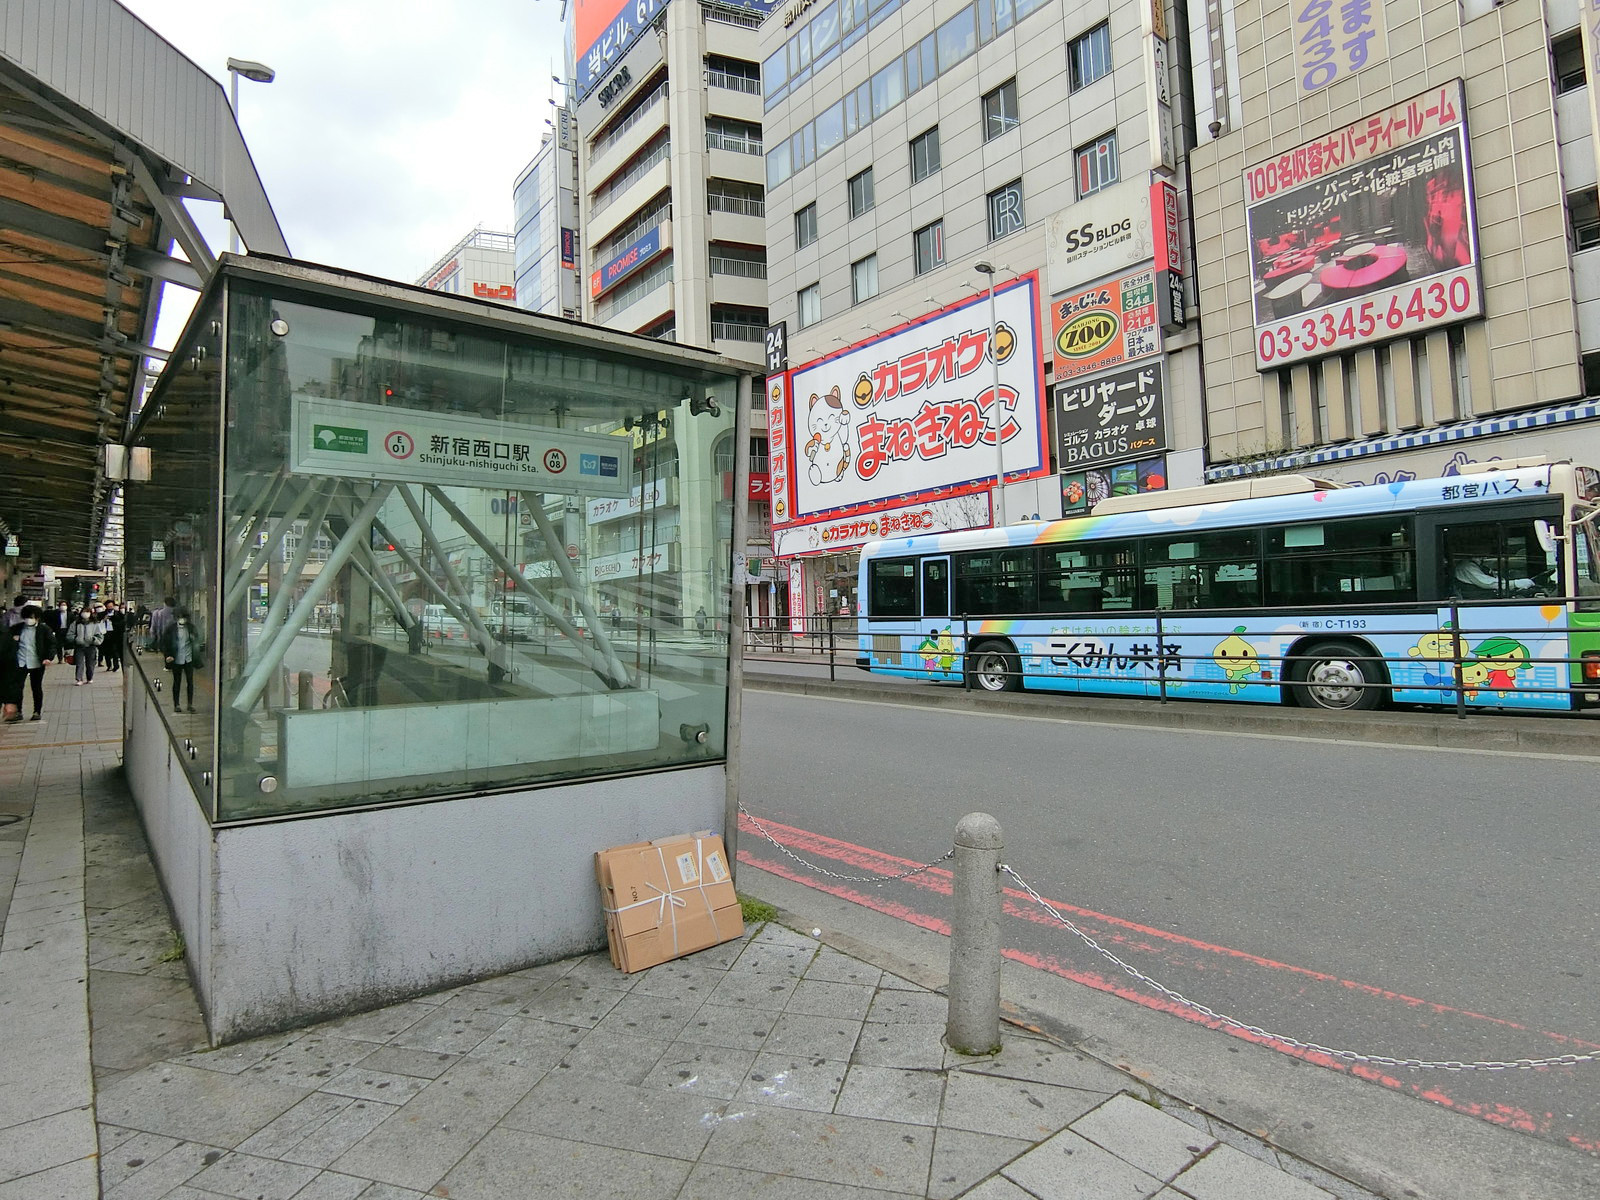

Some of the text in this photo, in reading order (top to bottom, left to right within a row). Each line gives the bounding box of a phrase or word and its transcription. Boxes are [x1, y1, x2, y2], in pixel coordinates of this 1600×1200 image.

[1247, 88, 1457, 202] 100名収容大パーティールーム
[1324, 136, 1455, 196] パーティールーム内
[1066, 218, 1131, 253] SS BLDG
[1165, 191, 1180, 265] カラオケ
[1066, 232, 1132, 264] 品川ステーションビル新宿
[592, 277, 600, 289] 6F
[608, 247, 638, 279] PROMISE
[1123, 273, 1150, 289] 完全分煙
[473, 282, 517, 301] ビック
[1072, 318, 1100, 330] MAHJONG
[1259, 276, 1471, 362] 03-3345-6430
[766, 328, 783, 355] 24
[1065, 320, 1111, 349] ZOO
[1128, 335, 1144, 348] 日本
[770, 354, 781, 371] H
[1128, 343, 1155, 358] 最大級
[872, 330, 990, 404] カラオケ
[1062, 355, 1122, 377] 03-3346-8889
[1063, 369, 1155, 412] ビリヤード
[1098, 394, 1156, 427] ダーツ
[856, 385, 1020, 479] まねきねこ
[1064, 417, 1157, 447] ゴルフ カラオケ 卓球
[392, 444, 405, 453] 01
[430, 434, 530, 462] 新宿西口駅
[551, 452, 559, 460] M
[770, 407, 786, 495] カラオケ
[1068, 437, 1128, 463] BAGUS
[419, 453, 539, 474] Shinjuku-nishiguchi Sta.
[549, 460, 561, 469] 08
[1441, 478, 1523, 501] 都営バス
[829, 510, 934, 541] カラオケ まねきねこ
[1325, 619, 1367, 629] C-T193
